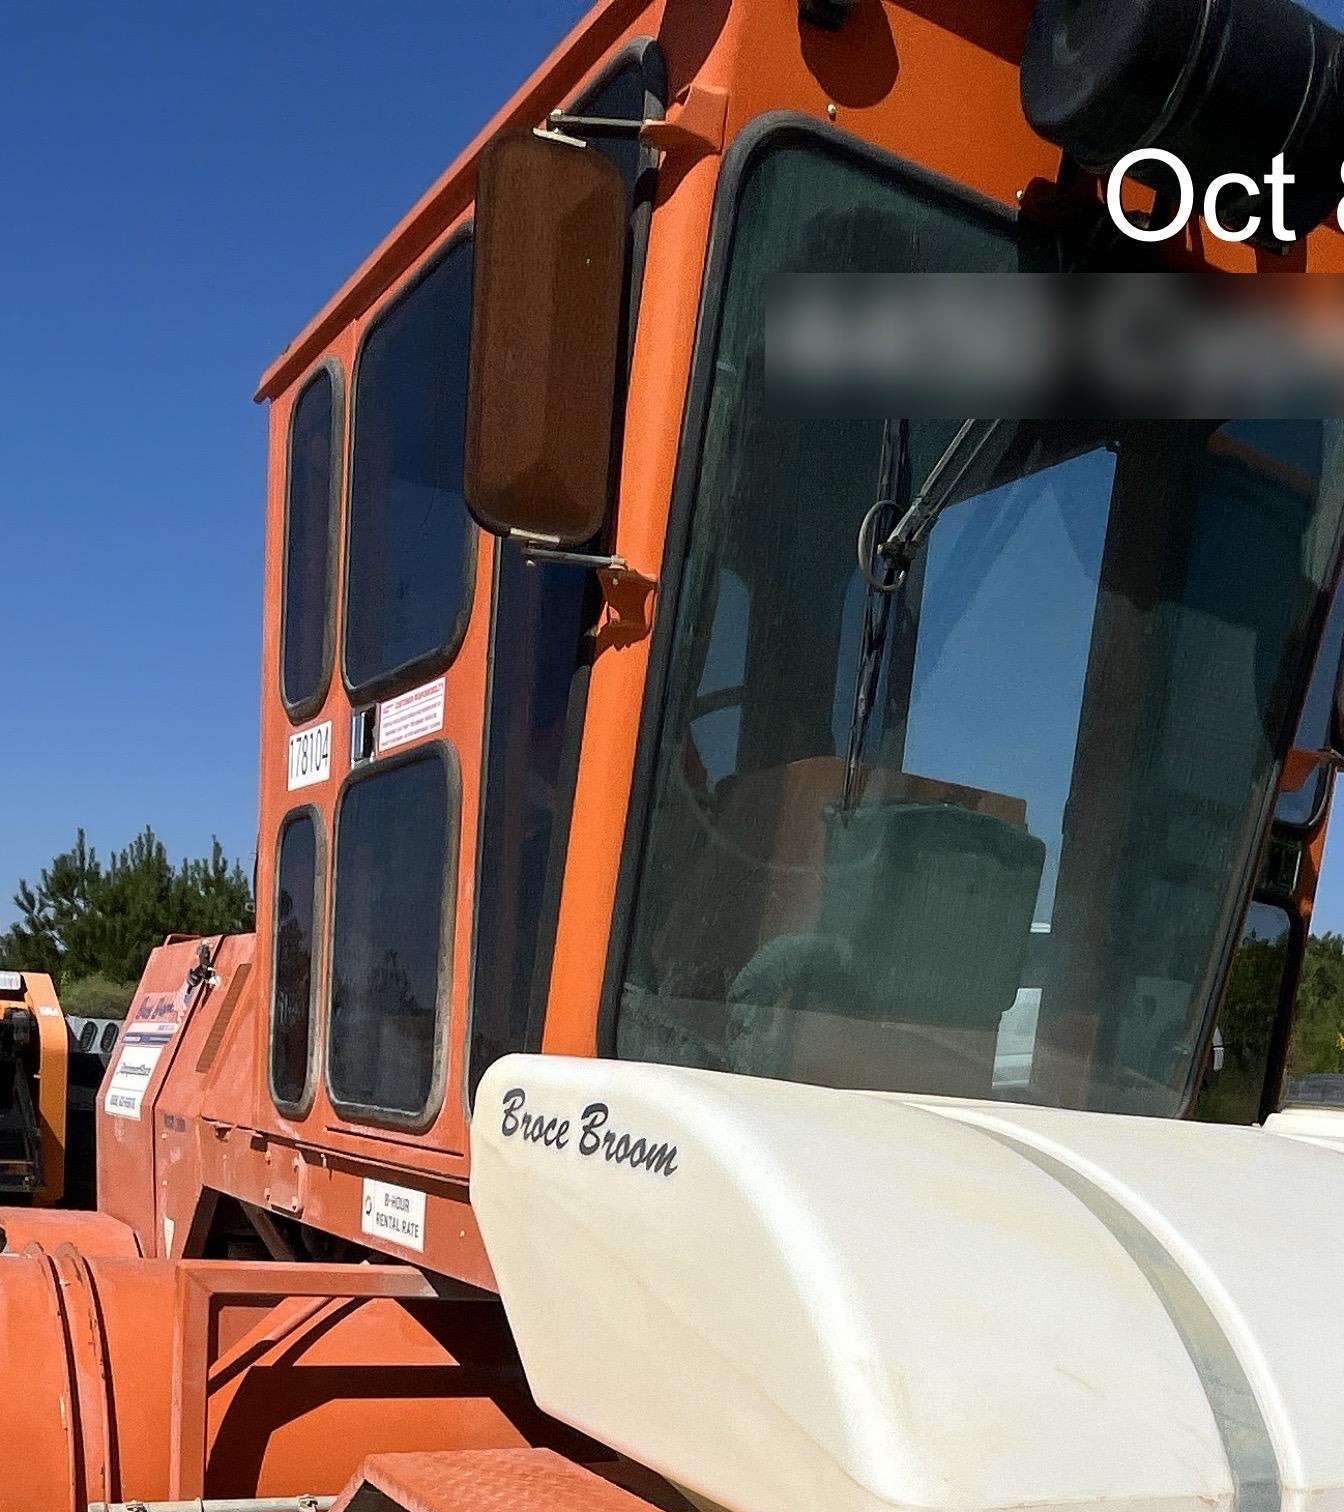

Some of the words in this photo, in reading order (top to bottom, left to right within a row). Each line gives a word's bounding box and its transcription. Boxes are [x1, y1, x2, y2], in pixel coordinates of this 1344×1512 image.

[290, 725, 329, 780] 178104
[501, 1087, 570, 1150] Broce
[579, 1102, 678, 1177] Broom
[376, 1212, 400, 1232] RENTAL
[402, 1220, 419, 1239] RATE
